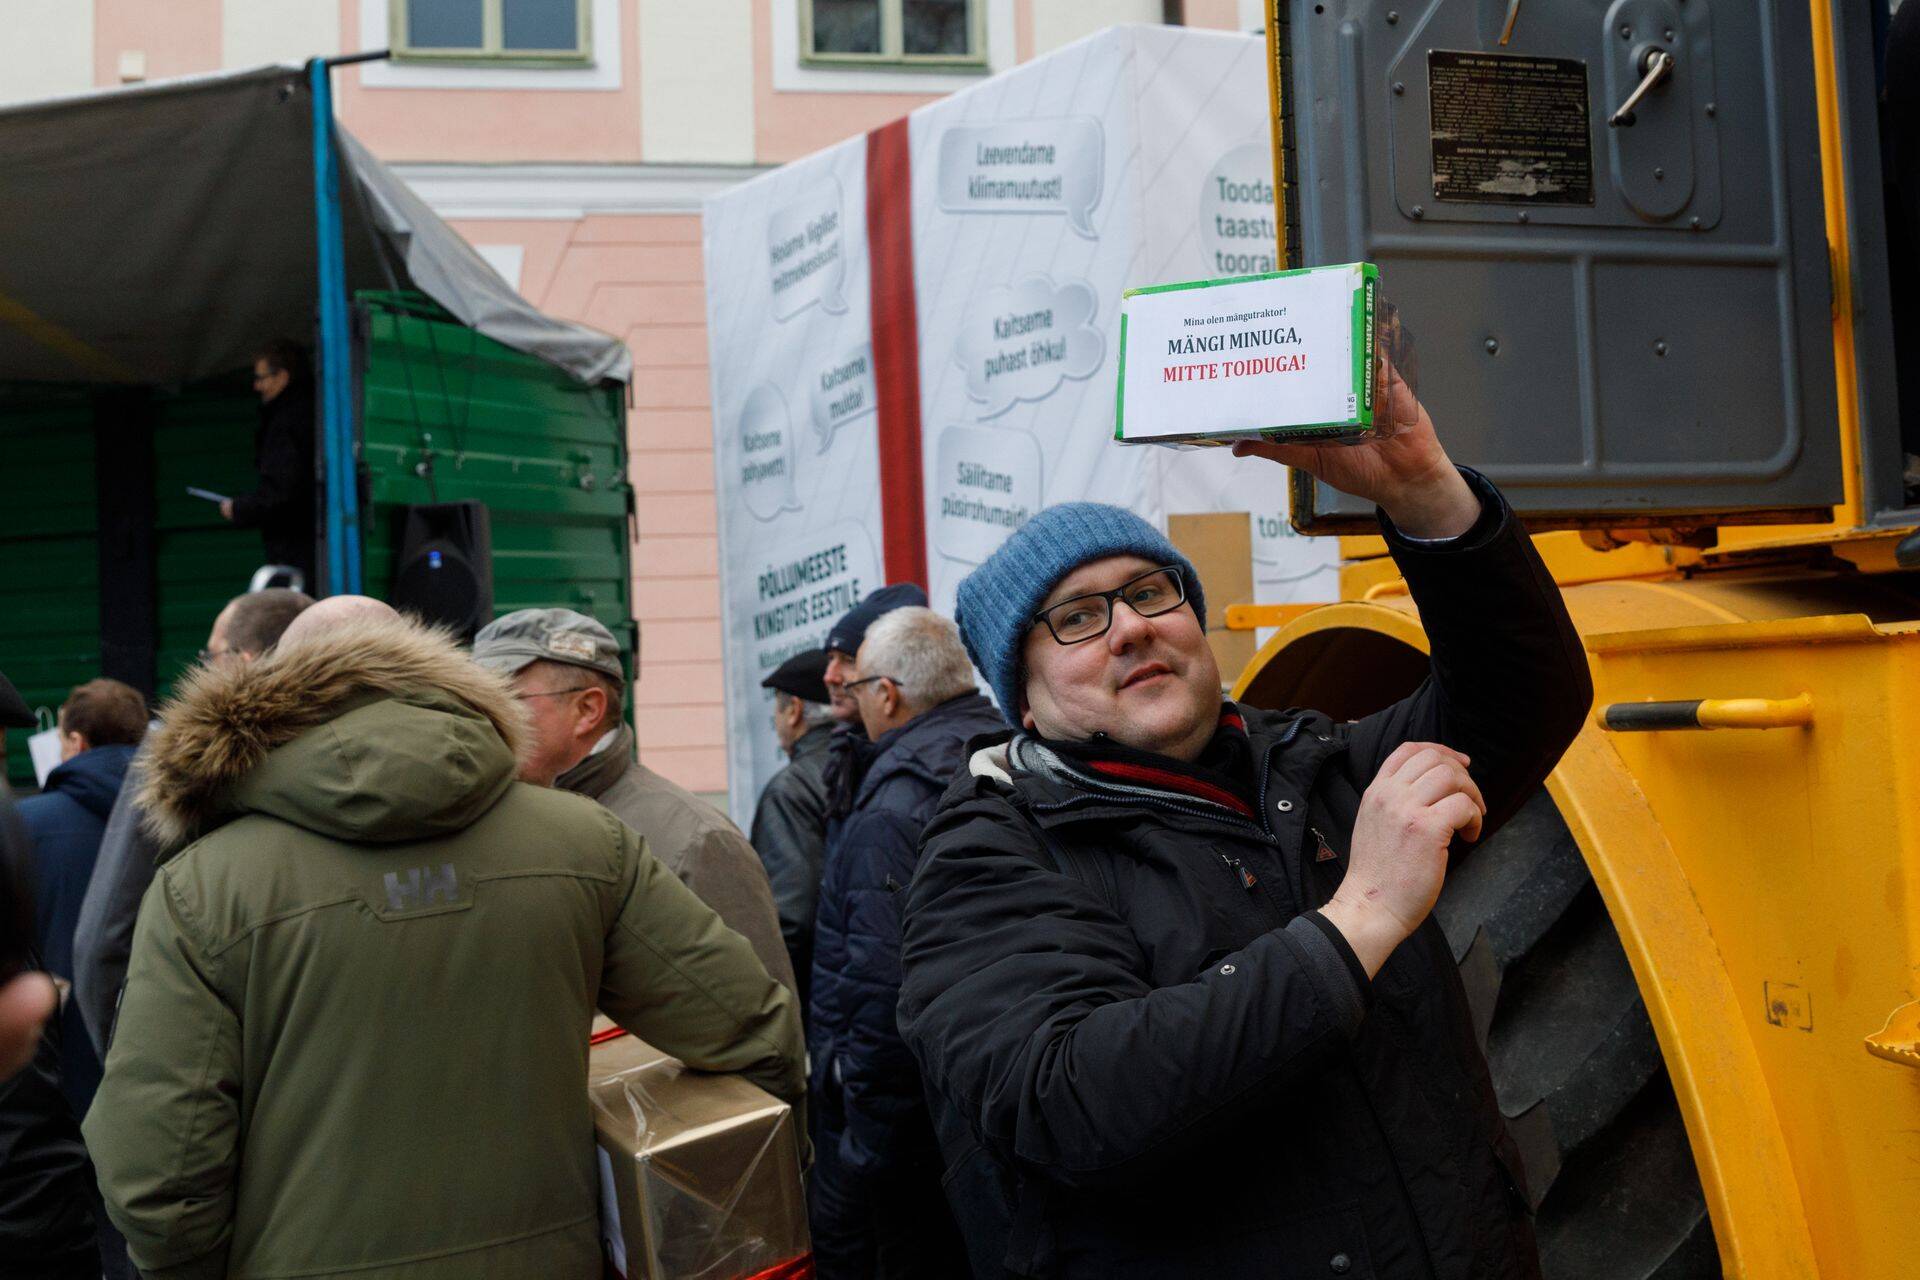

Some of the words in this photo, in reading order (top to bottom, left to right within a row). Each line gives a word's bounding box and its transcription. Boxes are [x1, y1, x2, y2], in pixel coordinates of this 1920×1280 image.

[977, 141, 1056, 166] Leevendame
[1365, 281, 1374, 312] THE
[993, 309, 1053, 341] Kaitseme
[1183, 317, 1205, 327] Mina
[1206, 315, 1225, 325] olen
[1226, 307, 1287, 322] mängutraktor!
[1167, 334, 1225, 356] MÄNGI
[1229, 327, 1302, 350] MINUGA,
[1365, 313, 1374, 354] FARM
[984, 347, 1027, 384] puhast
[1163, 363, 1218, 383] MITTE
[1222, 354, 1307, 378] TOIDUGA!
[1365, 356, 1374, 408] WORLD
[957, 461, 1013, 494] Säilitame
[758, 543, 847, 602] PÕLLUMEESTE
[753, 597, 809, 641] KINGITUS
[812, 578, 860, 621] EESTILE
